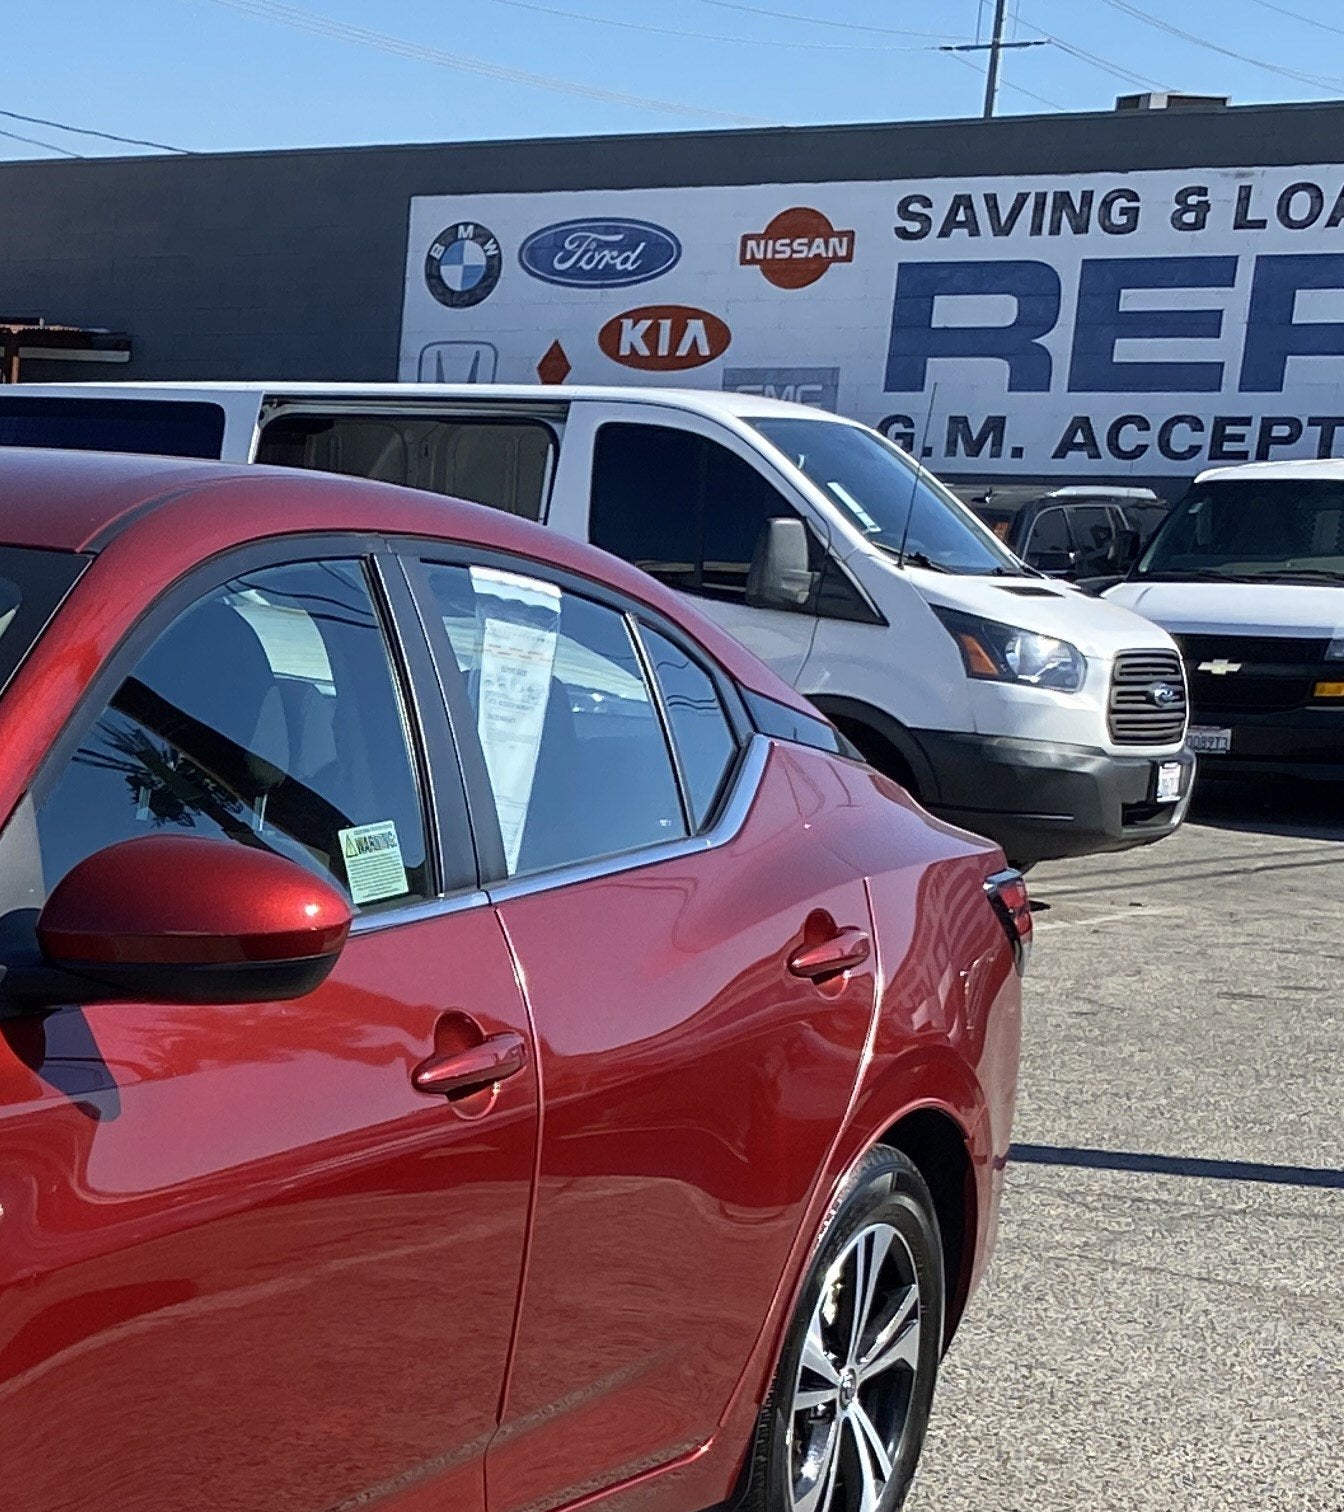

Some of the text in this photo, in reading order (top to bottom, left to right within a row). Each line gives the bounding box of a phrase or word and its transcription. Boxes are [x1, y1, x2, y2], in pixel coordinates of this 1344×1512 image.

[894, 188, 1141, 241] SAVING
[1170, 185, 1211, 232] &
[428, 223, 499, 260] BMW
[553, 232, 642, 271] Ford
[746, 236, 848, 261] NISSAN
[620, 319, 710, 356] KIA
[1052, 415, 1344, 461] ACCEPT
